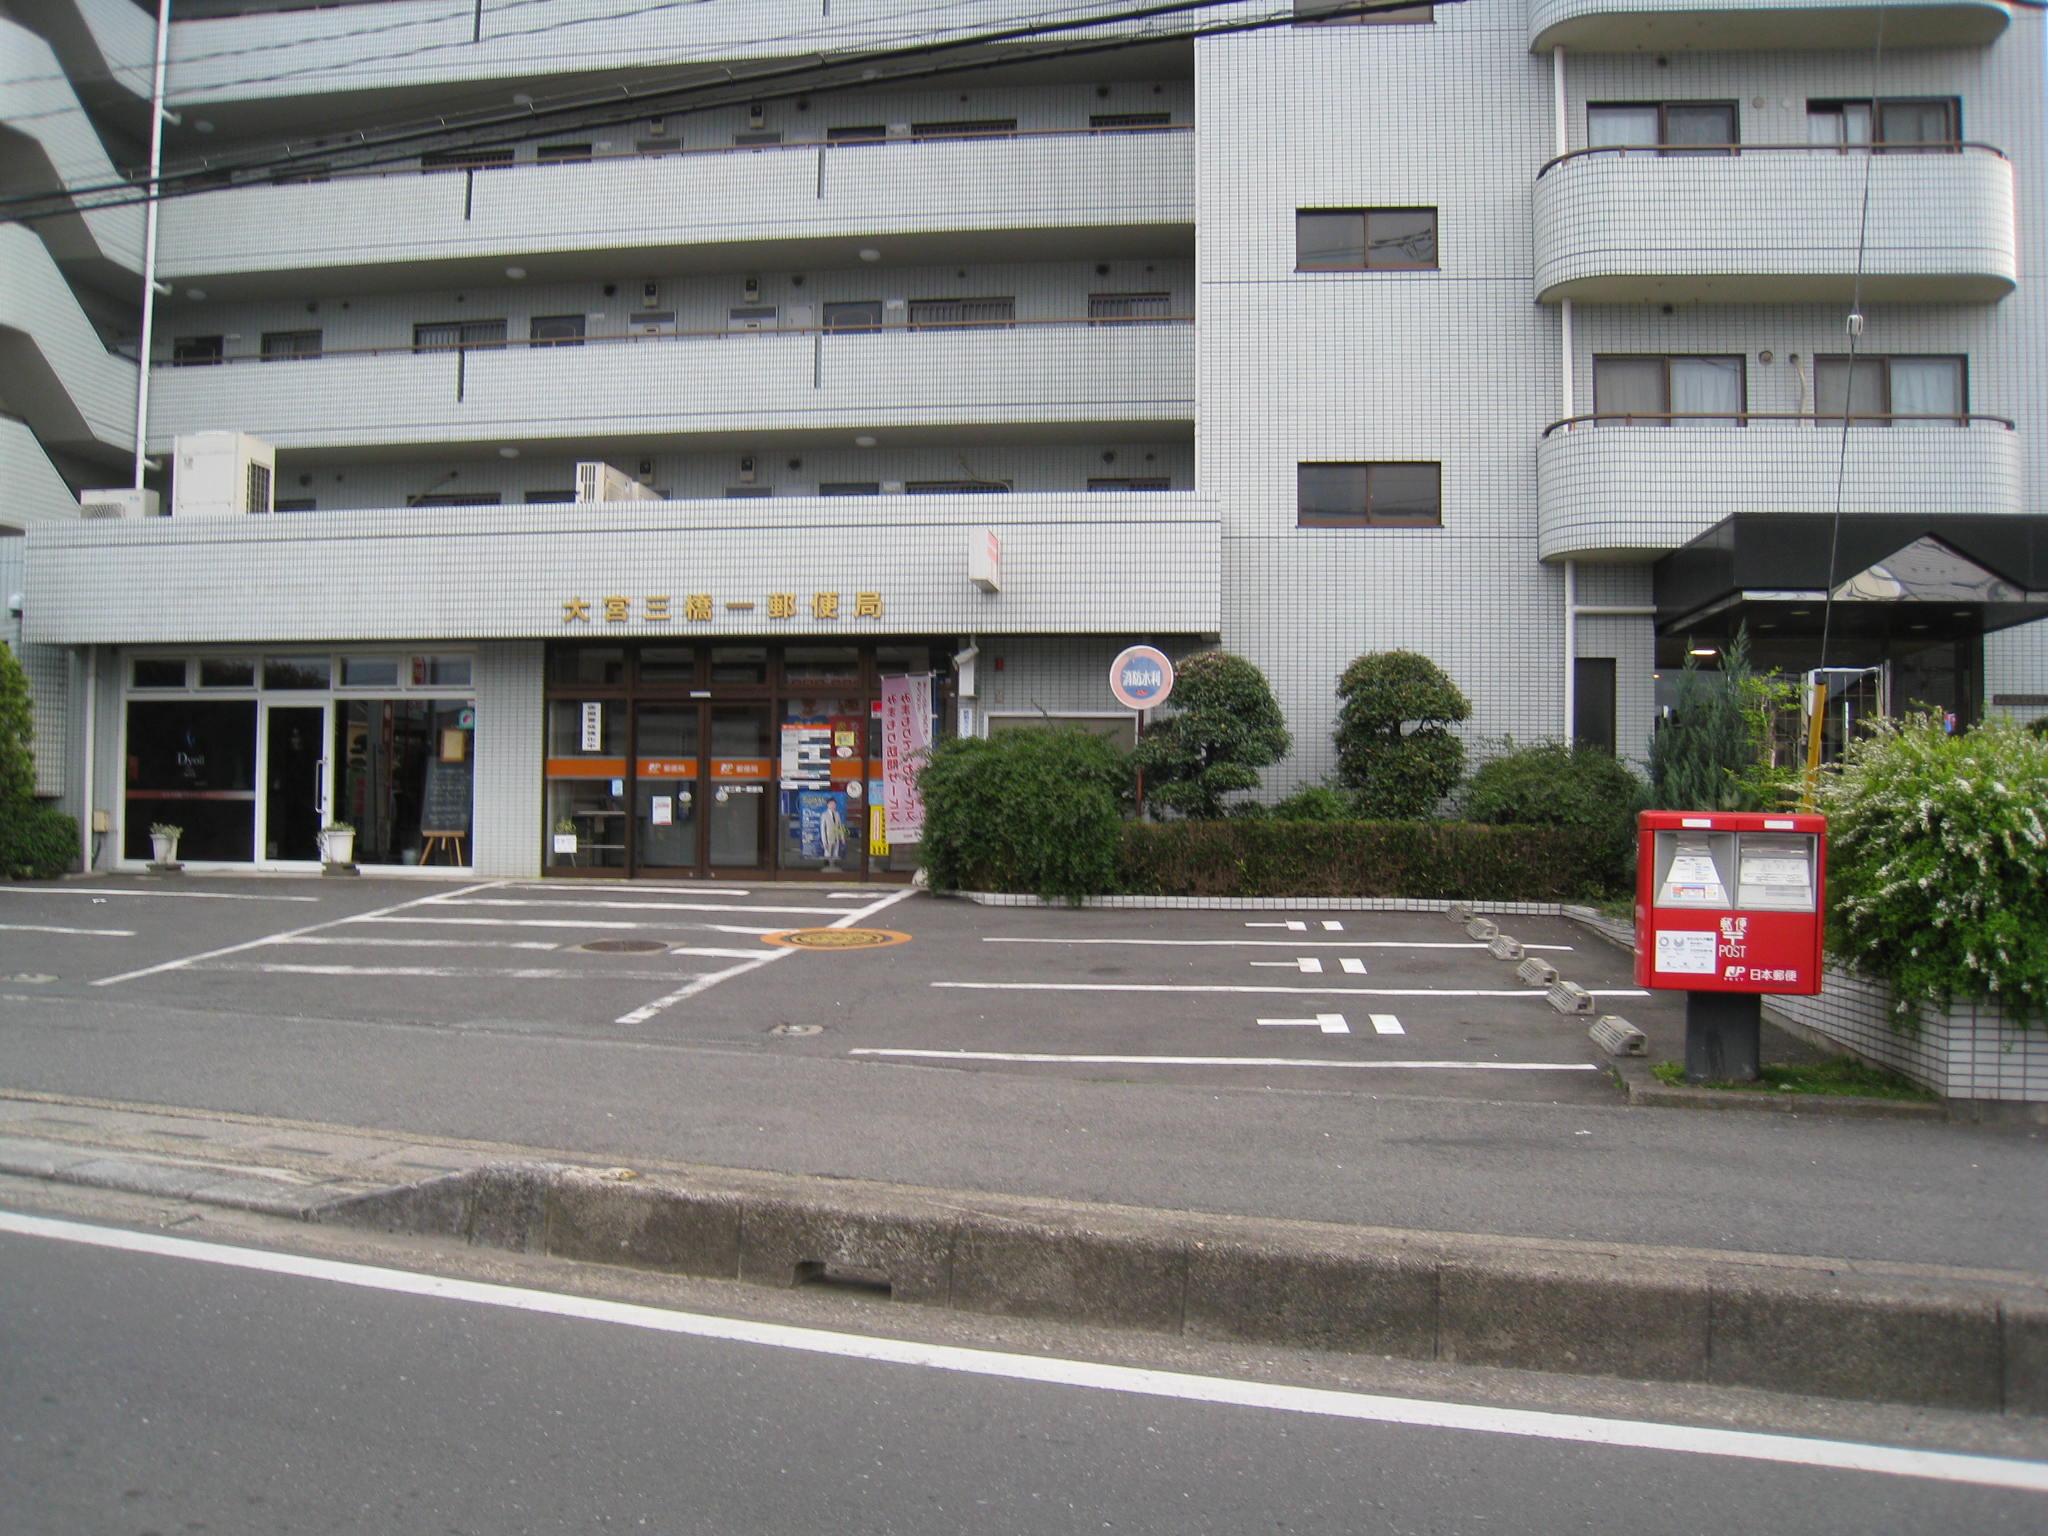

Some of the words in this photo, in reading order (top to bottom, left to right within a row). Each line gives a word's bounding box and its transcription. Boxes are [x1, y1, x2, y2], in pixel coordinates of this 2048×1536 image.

[563, 592, 884, 623] 大宮三橋一郵便局
[1720, 917, 1748, 933] 郵便
[1719, 945, 1747, 958] POST
[1750, 969, 1797, 982] 日本郵便
